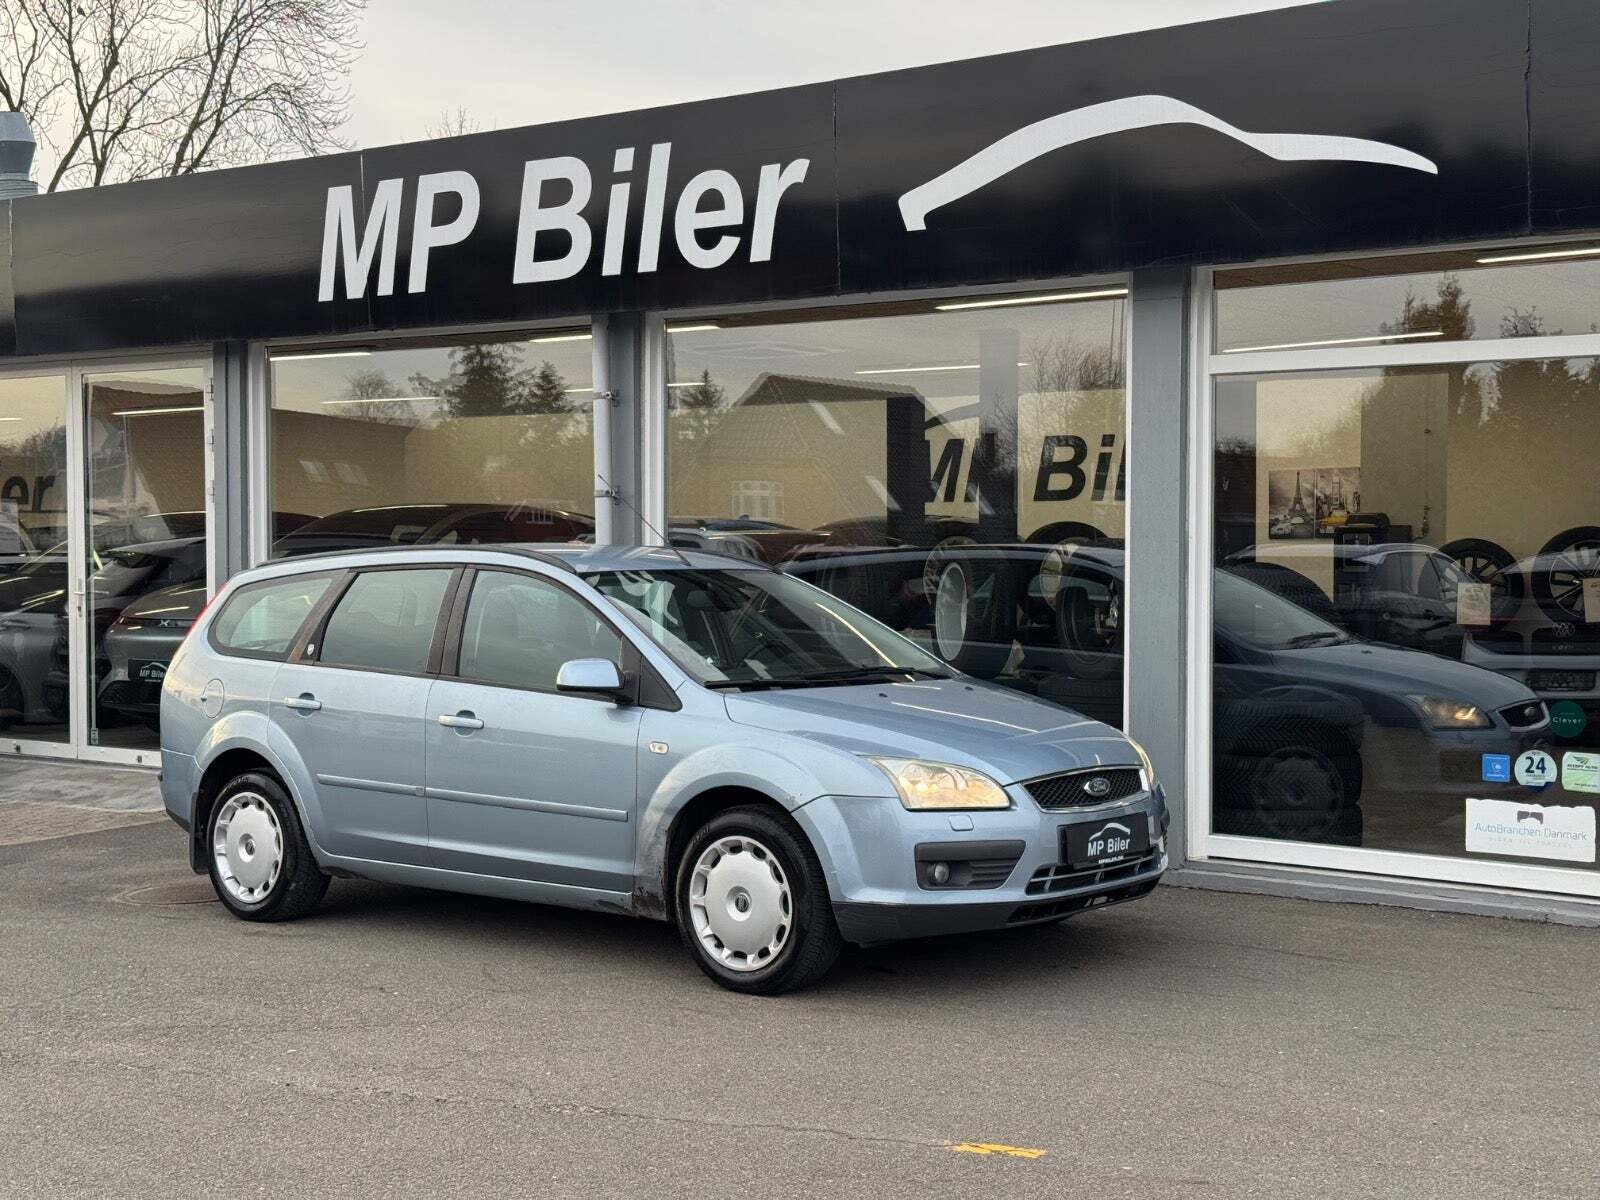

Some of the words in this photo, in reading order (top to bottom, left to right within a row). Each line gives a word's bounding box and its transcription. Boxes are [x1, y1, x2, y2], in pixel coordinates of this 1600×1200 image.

[317, 169, 481, 303] MP
[511, 141, 811, 285] Biler
[1525, 756, 1547, 774] 24
[1474, 822, 1541, 837] AutoBranchen
[1544, 827, 1588, 841] Danmark
[1087, 840, 1105, 857] MP
[1107, 837, 1131, 853] Biler
